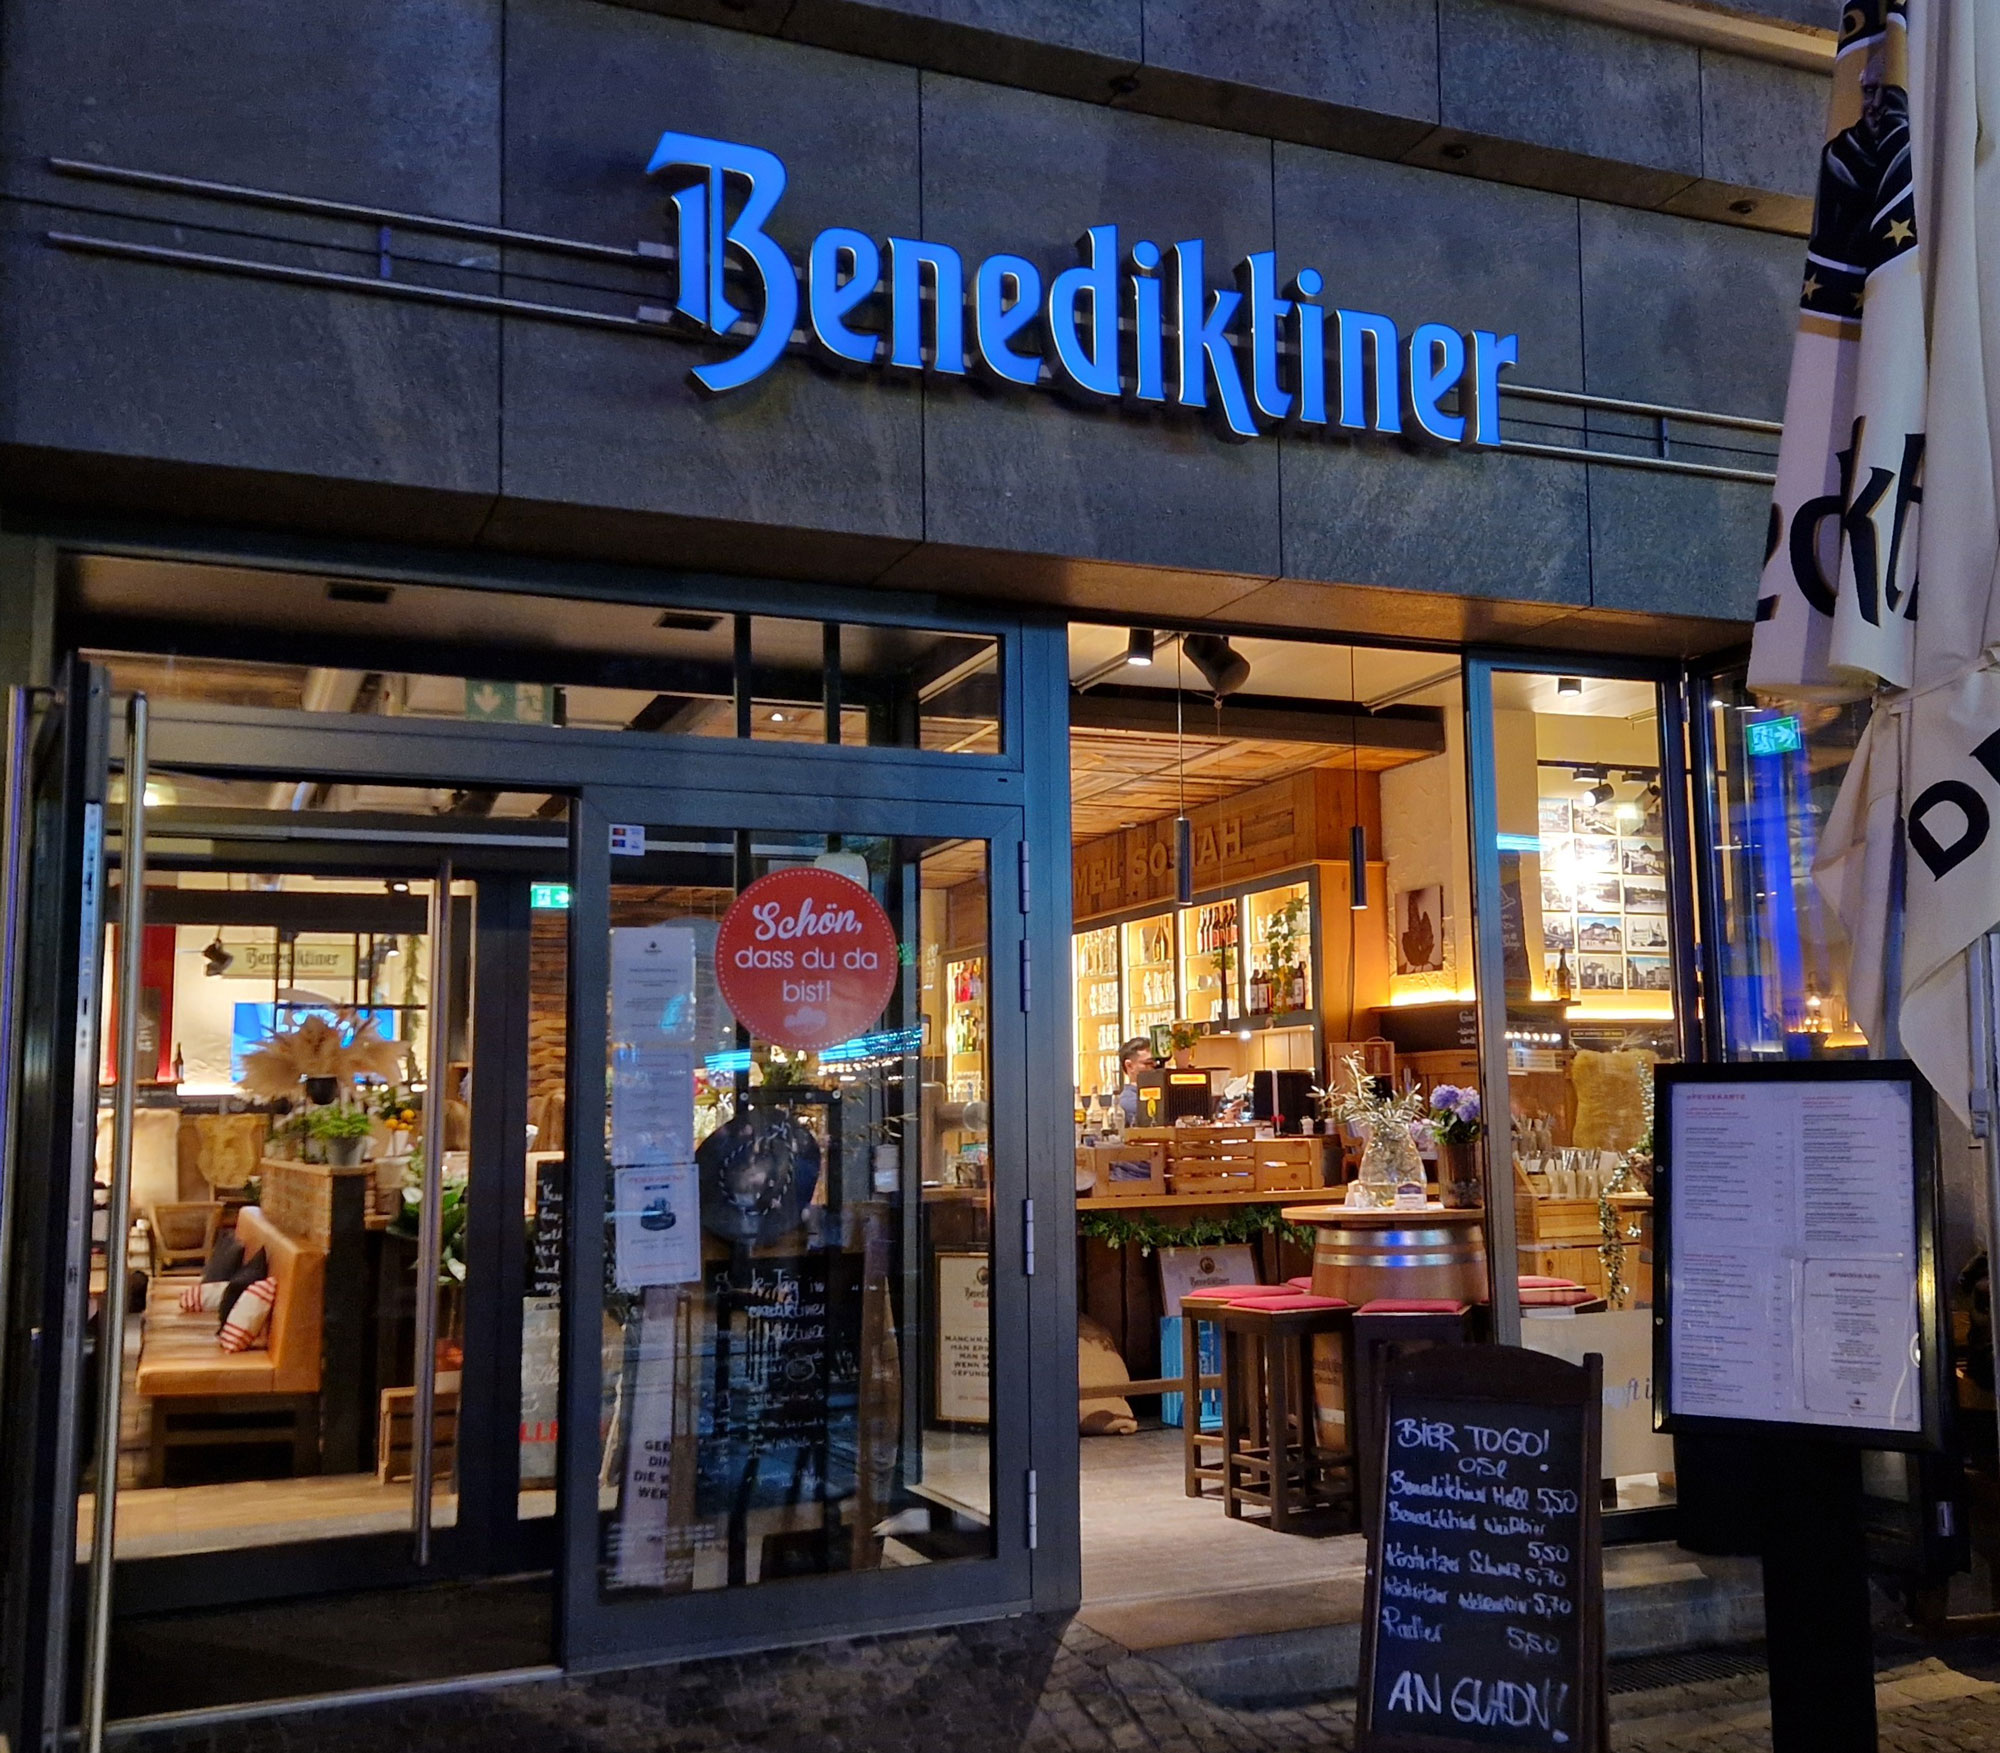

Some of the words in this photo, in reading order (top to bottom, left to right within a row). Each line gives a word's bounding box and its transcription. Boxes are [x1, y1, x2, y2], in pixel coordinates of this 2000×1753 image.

[645, 130, 1518, 447] Benediktiner
[752, 896, 864, 942] Schön,
[735, 945, 794, 970] dass
[801, 945, 836, 970] du
[843, 945, 878, 970] da
[782, 979, 832, 1003] bist!
[1492, 1485, 1530, 1513] Hell
[1536, 1487, 1580, 1517] 5,50
[1527, 1541, 1570, 1567] 5,50
[1524, 1567, 1567, 1589] 5,70
[1532, 1592, 1573, 1617] 5,70
[1382, 1607, 1444, 1644] Radler
[1505, 1626, 1561, 1656] 5,50
[1387, 1669, 1442, 1716] AN
